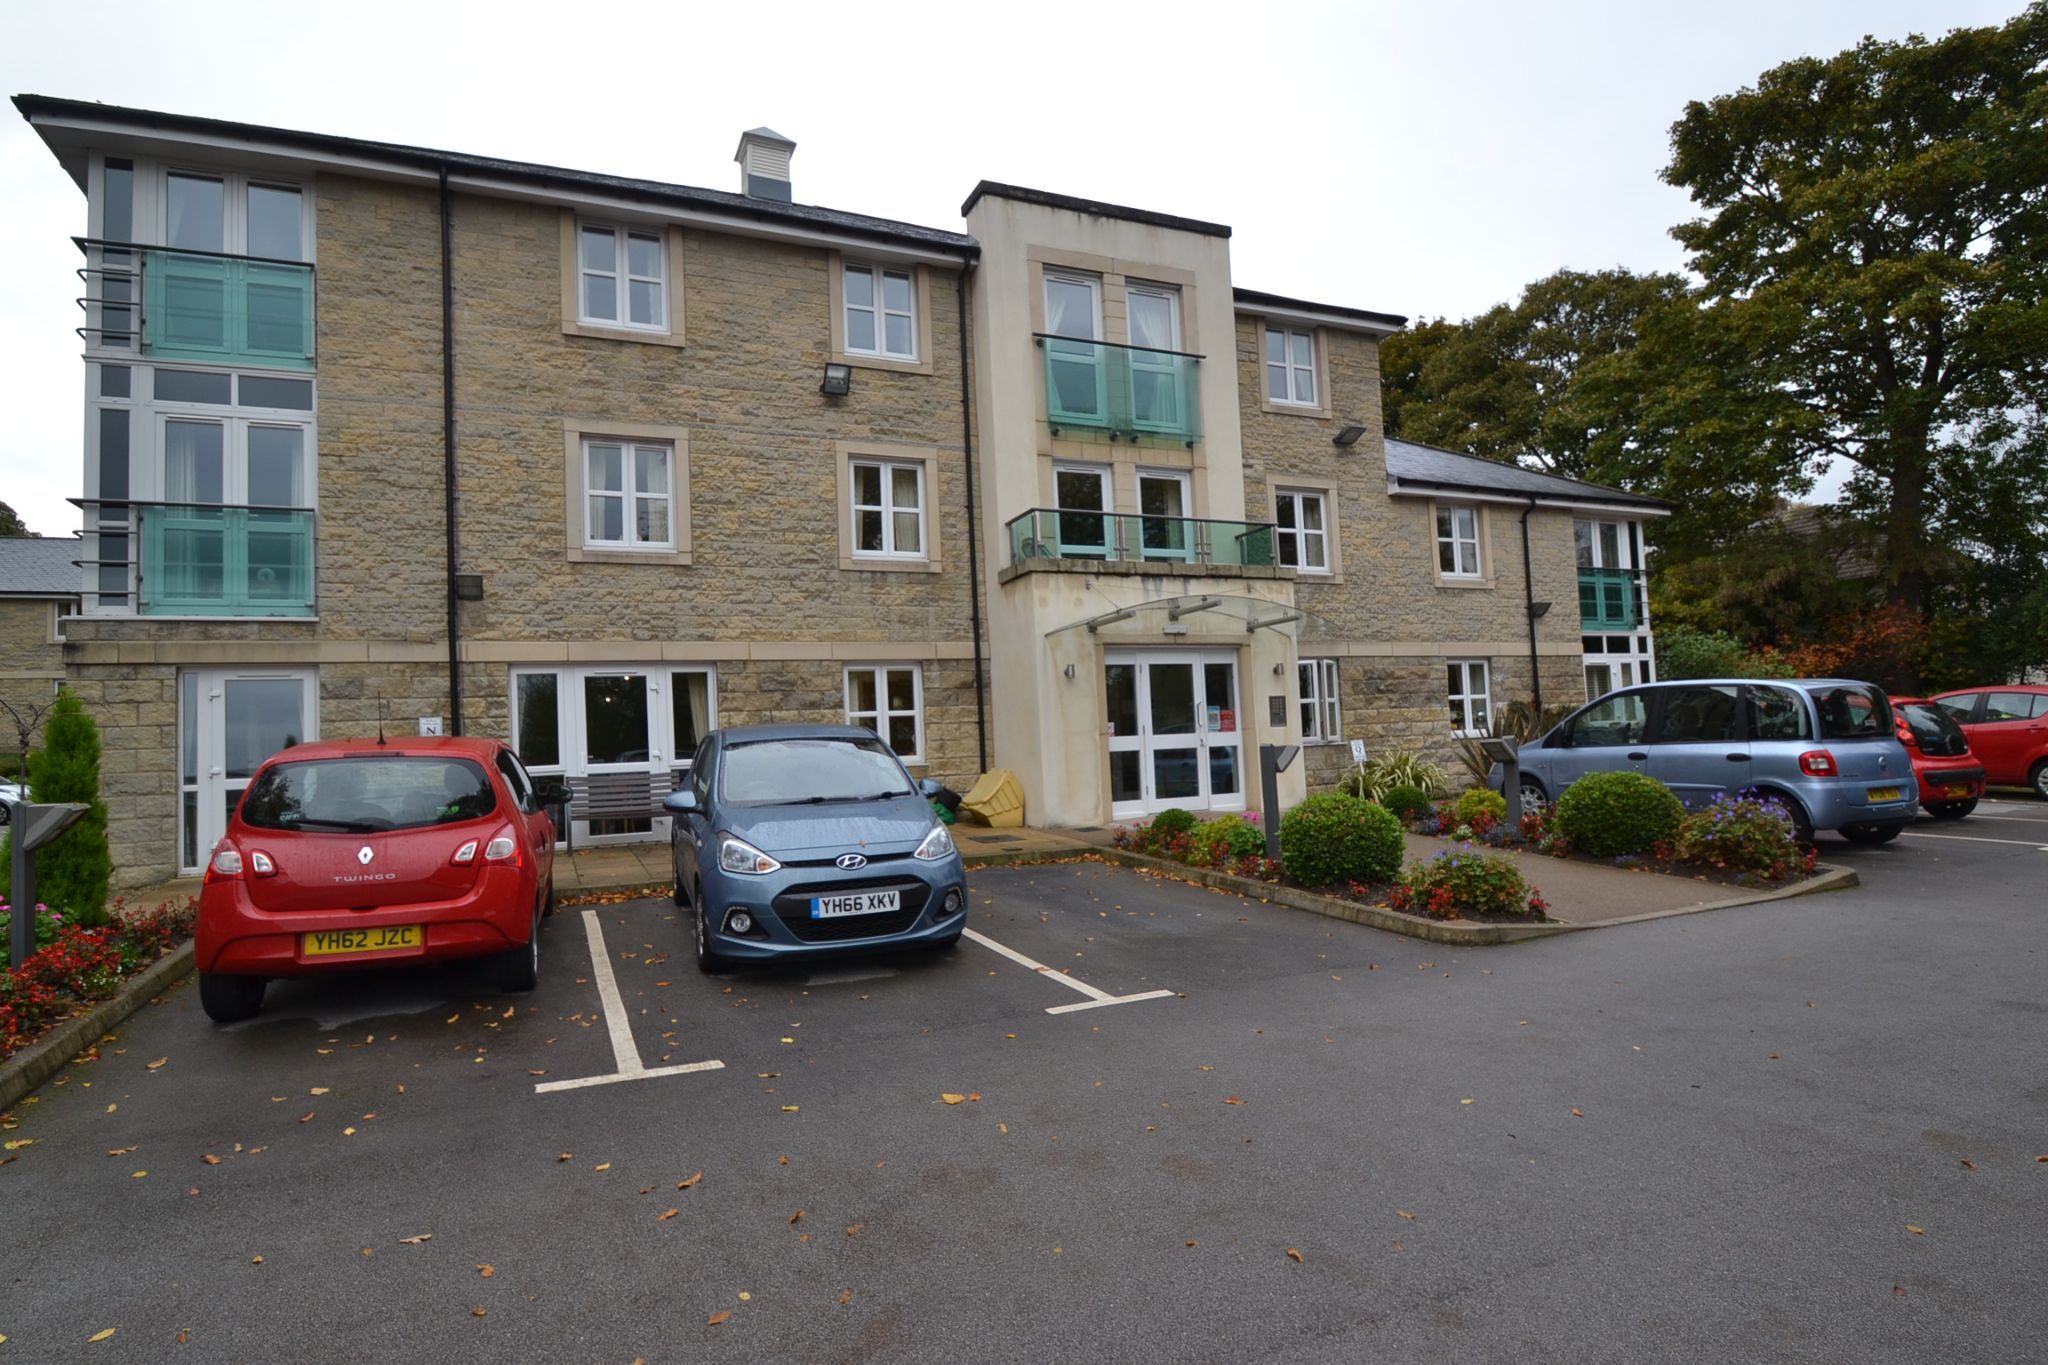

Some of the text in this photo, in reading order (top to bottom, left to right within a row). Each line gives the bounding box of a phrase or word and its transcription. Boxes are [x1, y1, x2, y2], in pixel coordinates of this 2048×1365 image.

[333, 873, 396, 882] TWINGO
[822, 893, 897, 914] YH66 XKV
[314, 928, 413, 950] YH62 JZC
